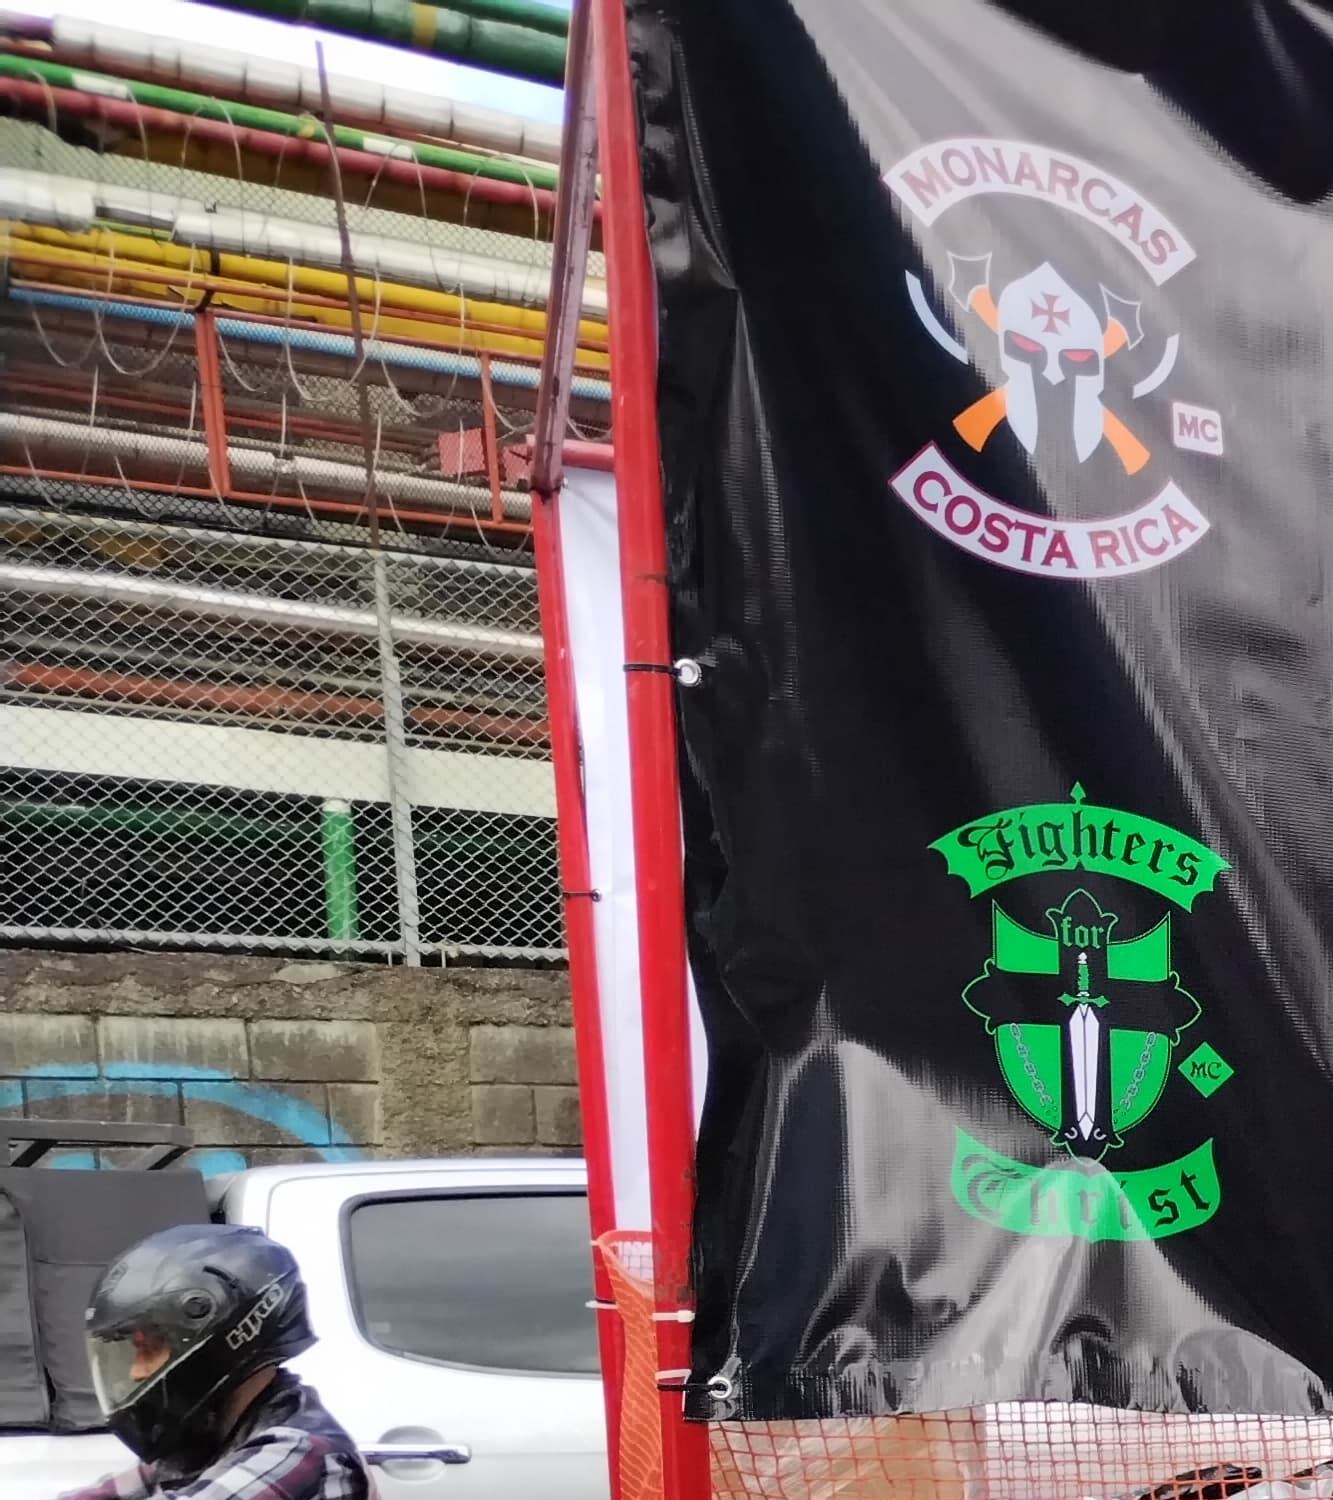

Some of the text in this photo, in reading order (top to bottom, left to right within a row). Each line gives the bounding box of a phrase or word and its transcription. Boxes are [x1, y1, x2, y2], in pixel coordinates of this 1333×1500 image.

[901, 145, 1177, 266] MONARCAS
[1178, 415, 1218, 442] MC
[913, 470, 1198, 569] COSTA RICA
[957, 811, 1203, 887] Fighters
[1061, 917, 1104, 948] for
[1190, 1061, 1221, 1081] MC
